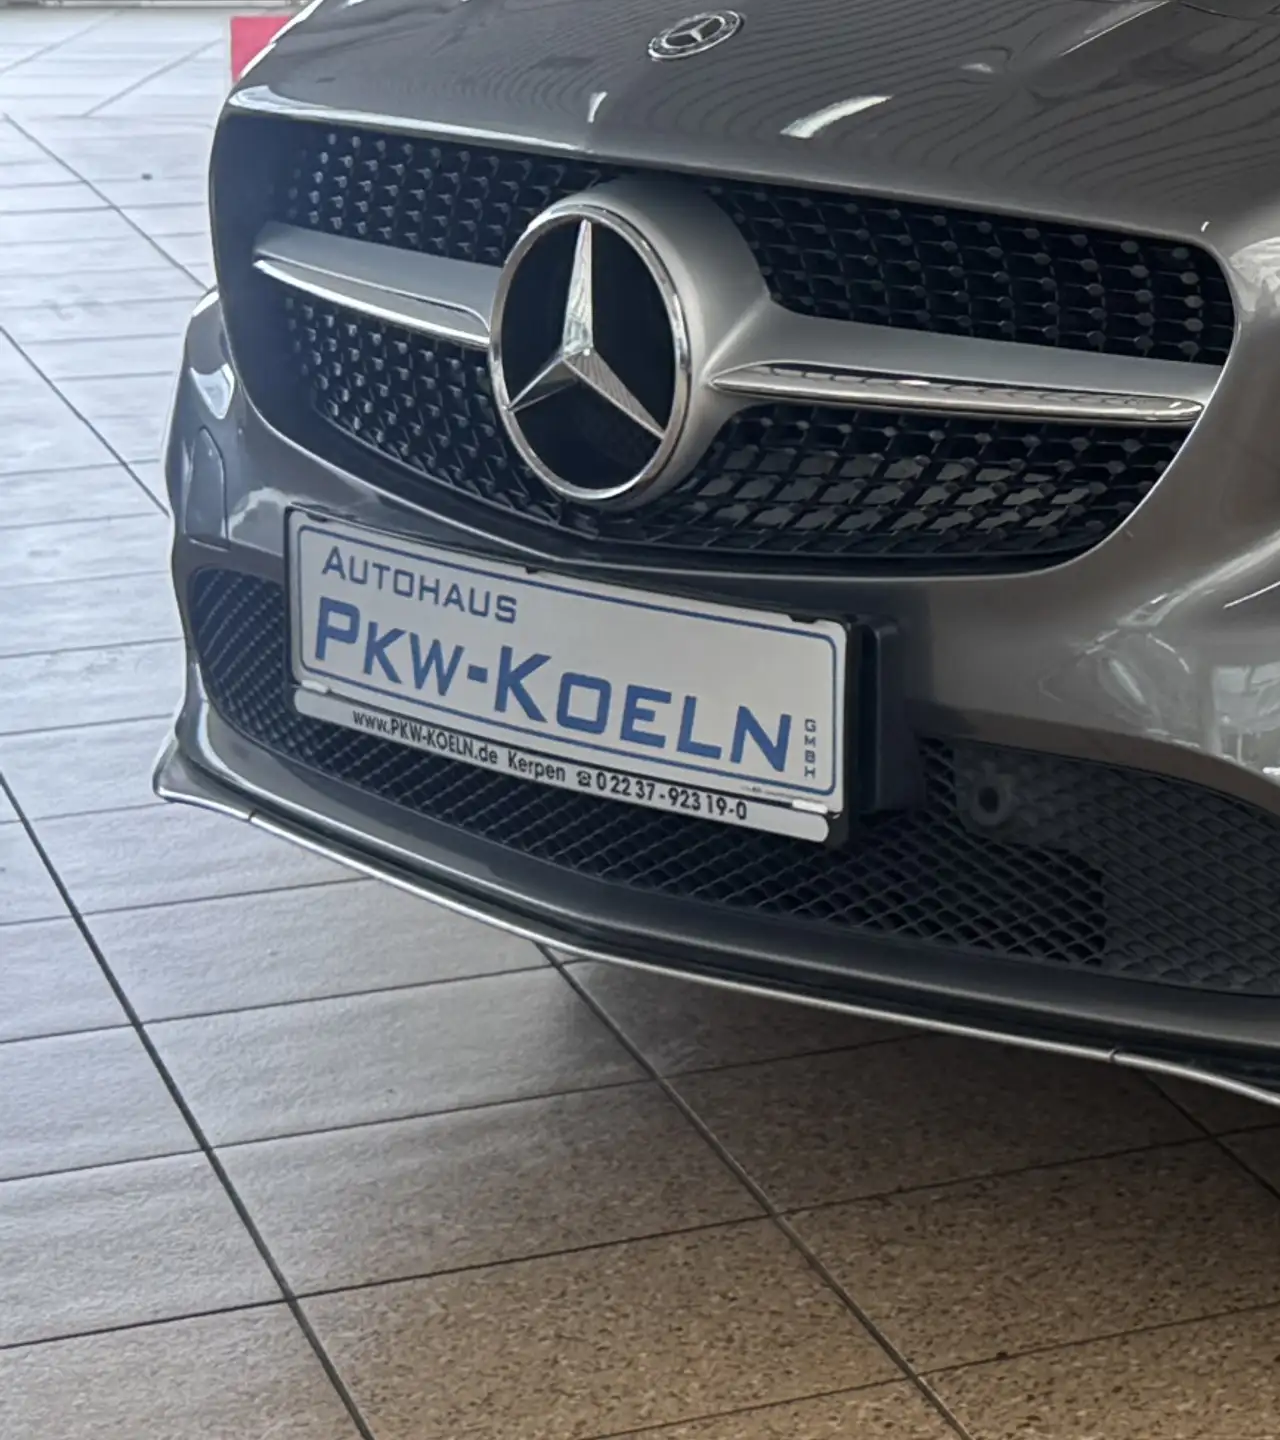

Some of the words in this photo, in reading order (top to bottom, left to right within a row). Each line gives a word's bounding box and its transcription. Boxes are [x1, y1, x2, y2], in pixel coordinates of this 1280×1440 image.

[322, 546, 518, 624] AUTOHAUS
[314, 596, 792, 773] PKW-KOELN
[352, 710, 498, 764] www.PKW-KOELN.de
[507, 749, 566, 782] Kerpen
